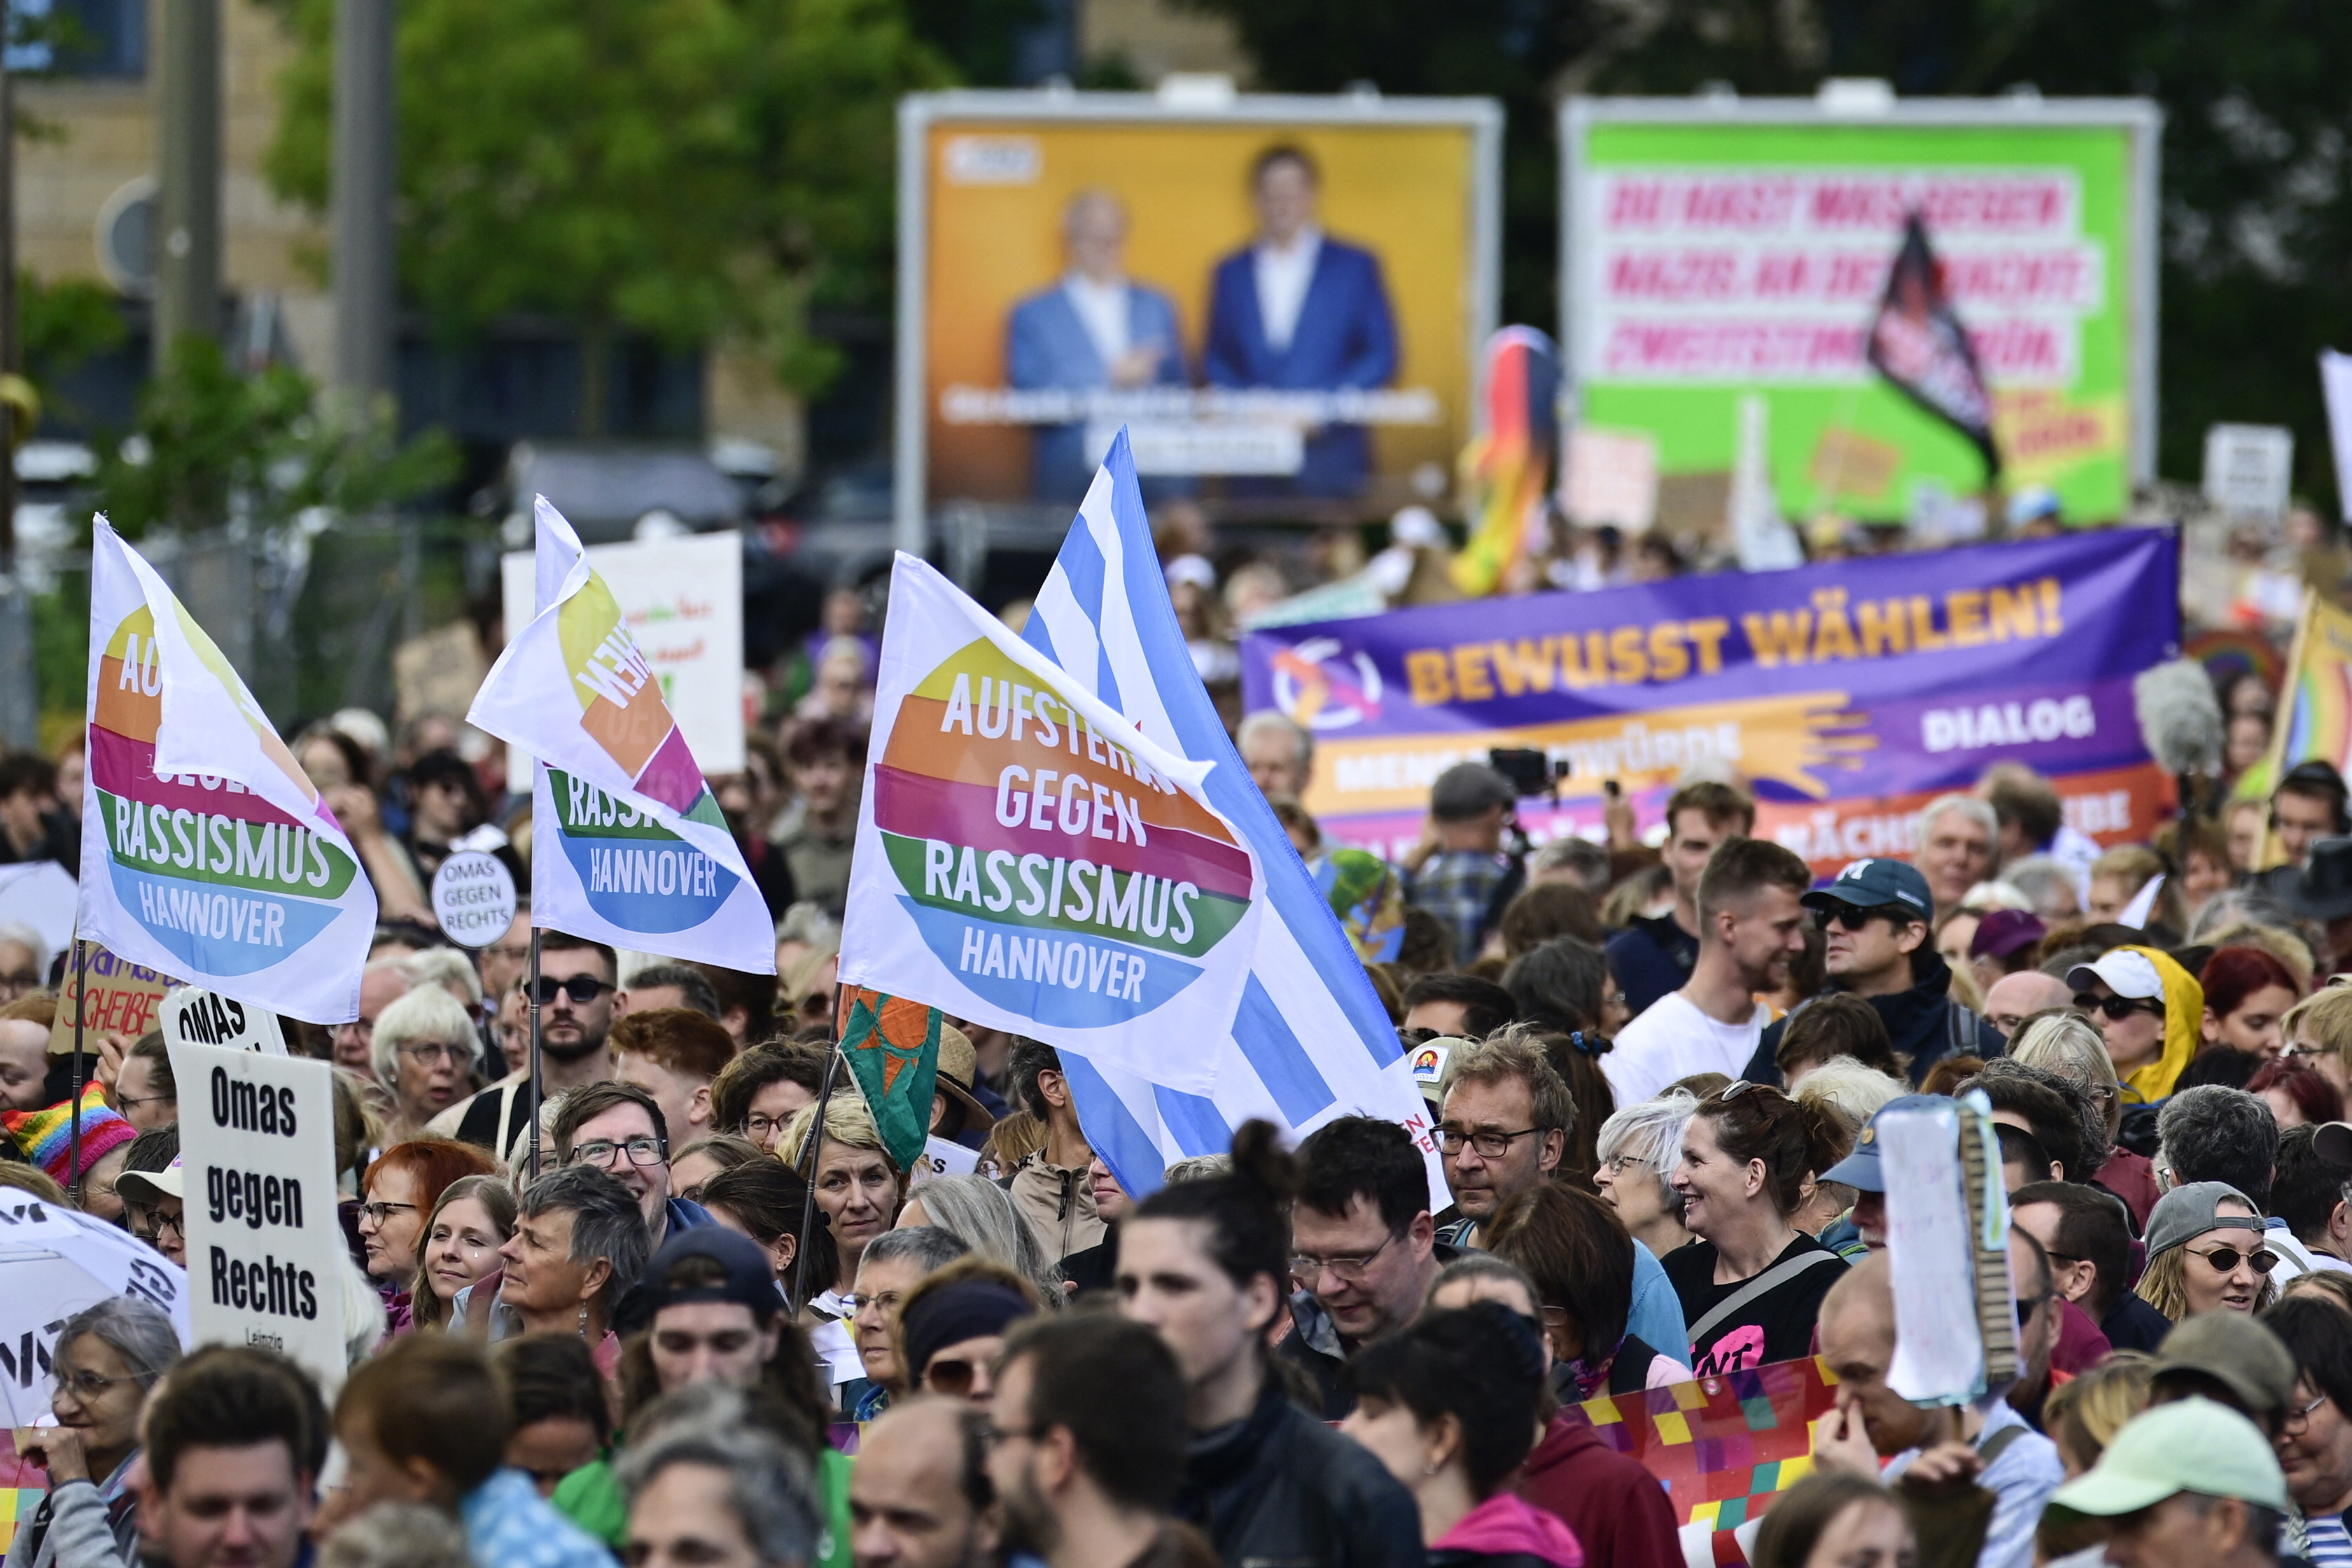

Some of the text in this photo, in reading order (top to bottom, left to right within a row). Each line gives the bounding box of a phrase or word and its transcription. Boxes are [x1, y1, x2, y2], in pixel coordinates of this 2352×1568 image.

[1404, 576, 2064, 708] BEWUSST WÄHLEN!
[1921, 694, 2096, 753] DIALOG
[995, 764, 1147, 848] GEGEN
[115, 795, 330, 888] RASSISMUS
[444, 860, 496, 883] OMAS
[590, 848, 717, 897] HANNOVER
[139, 881, 285, 947] HANNOVER
[443, 883, 502, 907] GEGEN
[446, 908, 510, 930] RECHTS
[925, 839, 1199, 944] RASSISMUS
[960, 926, 1147, 1002] HANNOVER
[179, 991, 246, 1045] OMAS
[211, 1065, 297, 1138] Omas
[207, 1165, 303, 1230] gegen
[210, 1245, 318, 1320] Rechts
